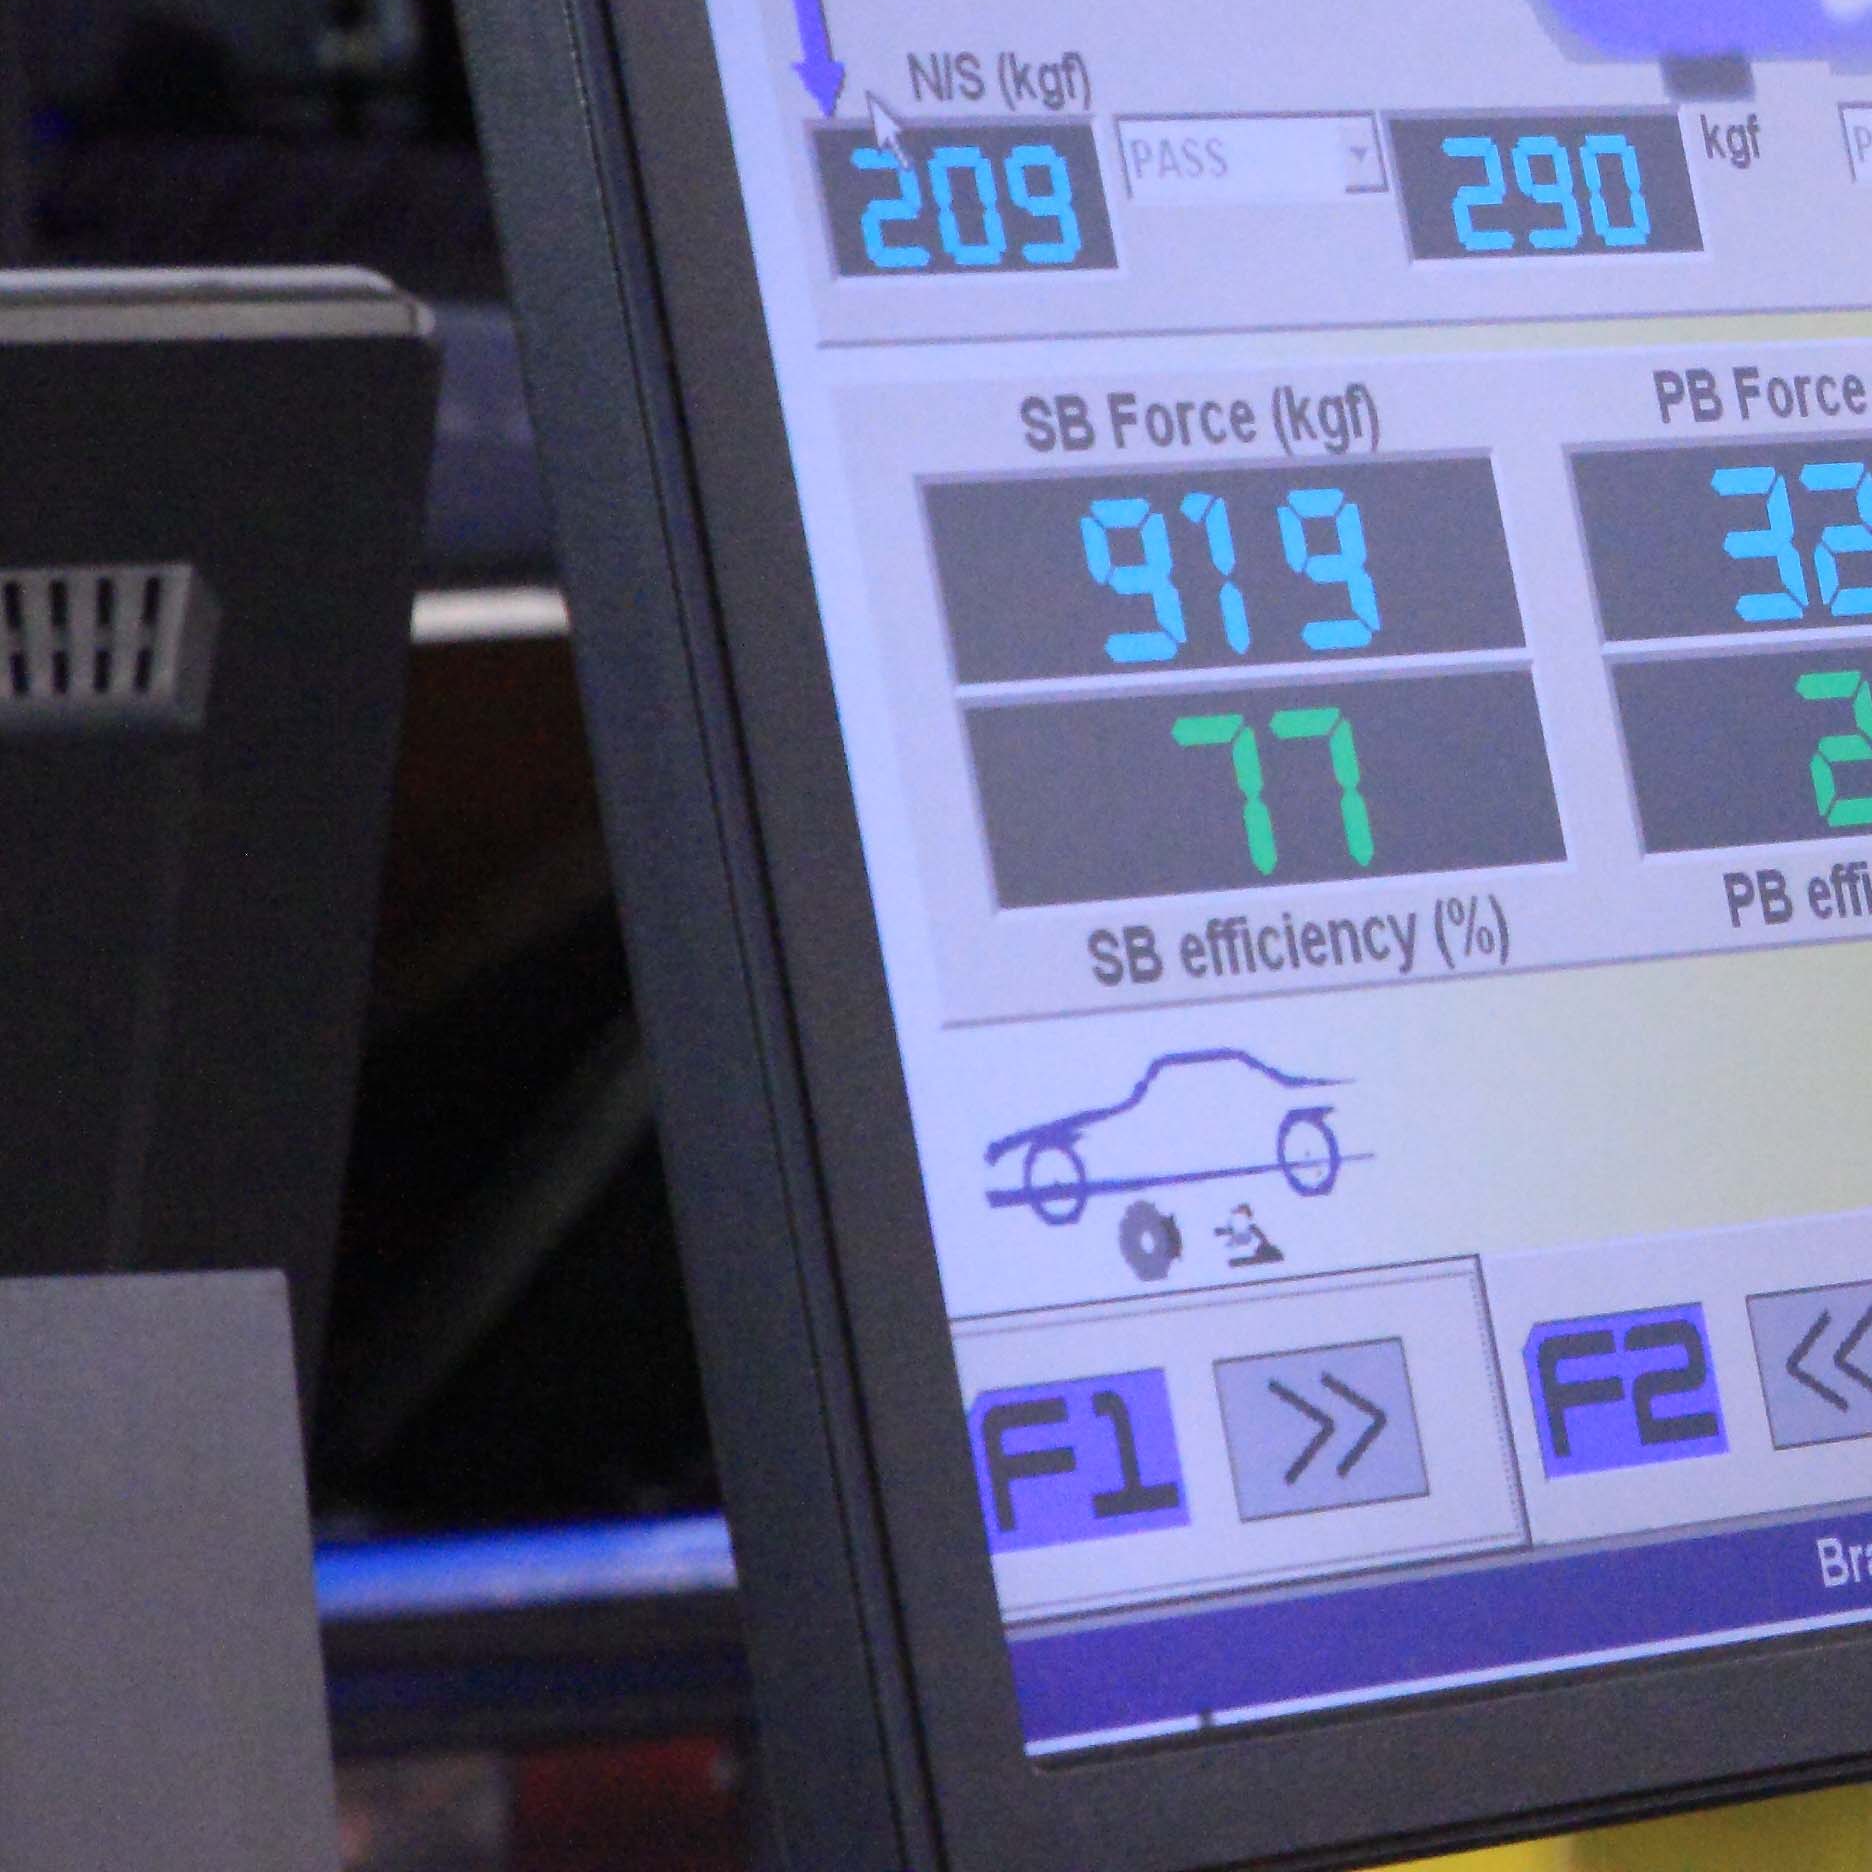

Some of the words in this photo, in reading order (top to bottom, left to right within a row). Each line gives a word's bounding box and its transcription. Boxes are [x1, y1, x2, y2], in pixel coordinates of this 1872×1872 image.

[1000, 49, 1091, 114] (kgf)
[851, 143, 1082, 269] 209
[1131, 135, 1229, 180] PASS
[1442, 134, 1651, 252] 290
[1701, 112, 1763, 169] kgf
[1021, 395, 1095, 452] SB
[1109, 390, 1256, 449] Force
[1272, 382, 1382, 454] (kgf)
[1656, 368, 1723, 424] PB
[1734, 362, 1865, 417] Force
[1080, 488, 1383, 663] 919
[1171, 707, 1375, 877] 77
[1088, 925, 1164, 987] SB
[1179, 911, 1418, 977] efficiency
[1434, 894, 1511, 968] (%)
[1724, 870, 1794, 929] PB
[1538, 1318, 1719, 1460] F2
[977, 1389, 1181, 1533] F1
